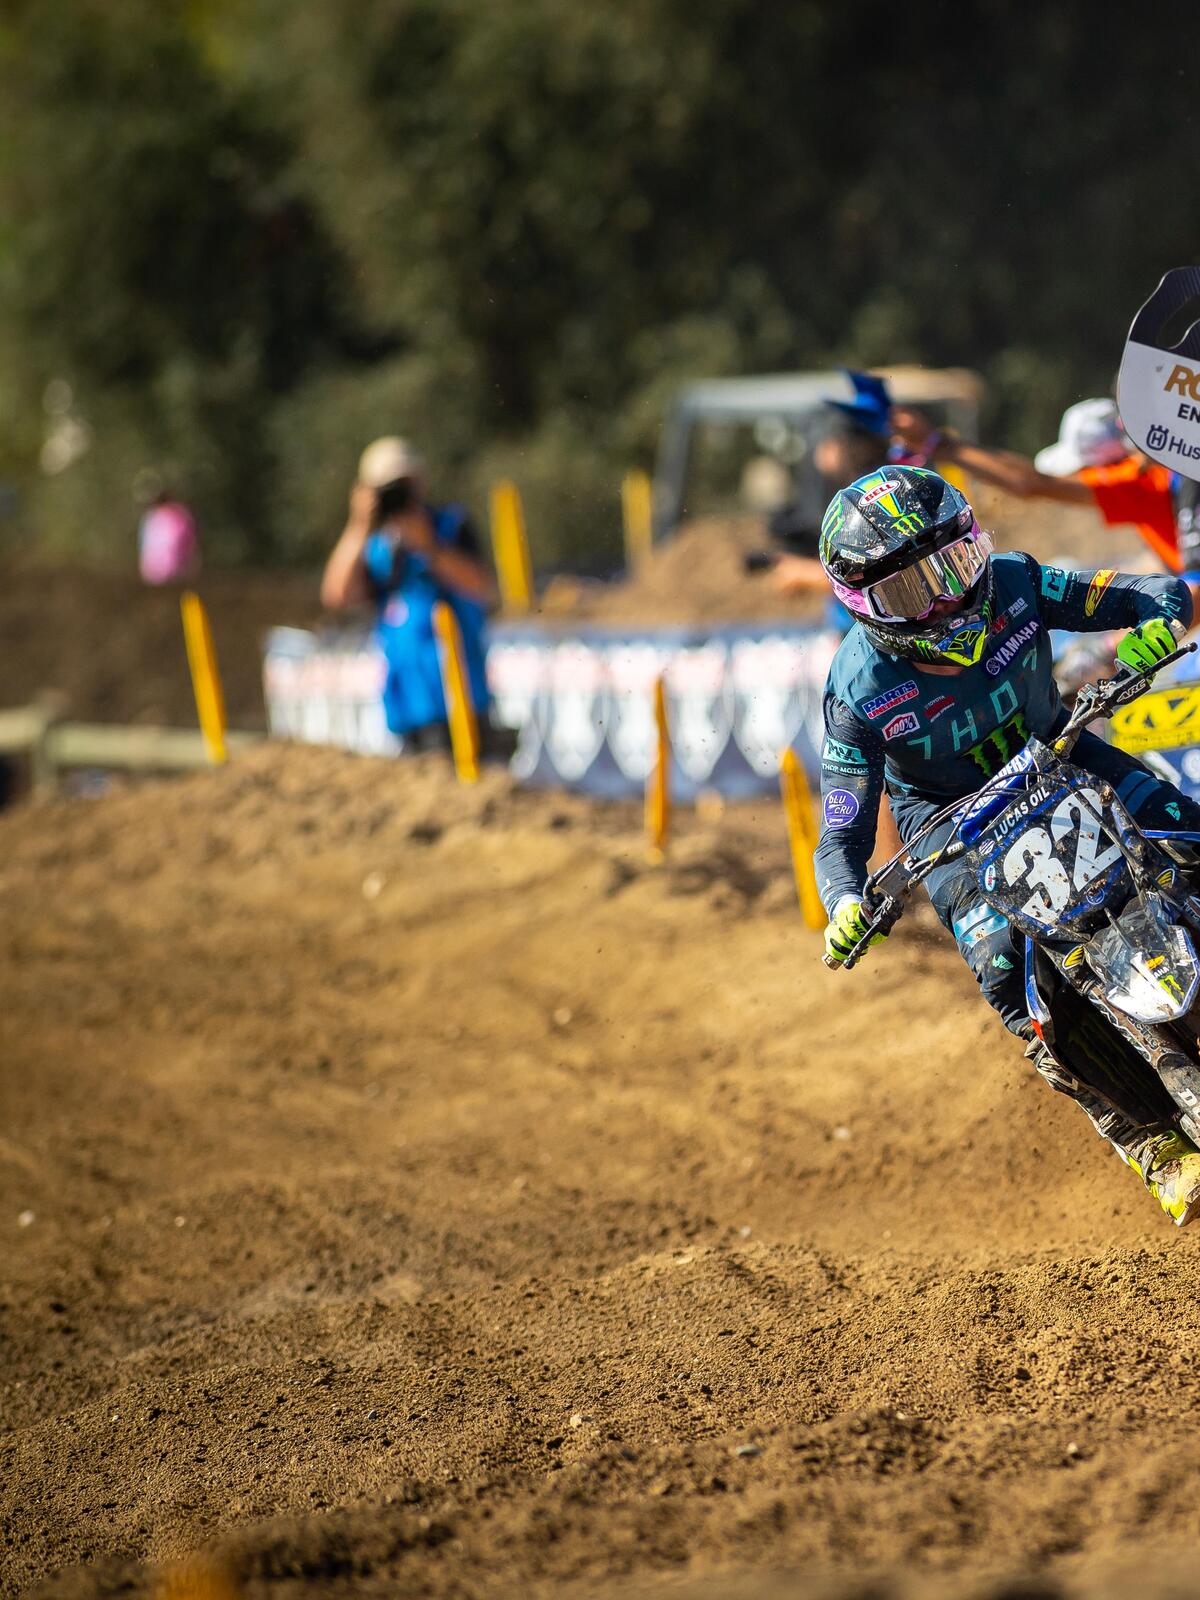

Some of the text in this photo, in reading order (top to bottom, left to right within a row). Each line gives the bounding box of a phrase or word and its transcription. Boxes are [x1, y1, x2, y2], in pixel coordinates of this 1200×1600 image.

[864, 481, 893, 502] BELL
[1007, 597, 1026, 614] PRO
[995, 621, 1040, 667] YAMAHA
[863, 681, 917, 714] PARTS
[868, 688, 919, 718] UNLIMITED
[1116, 678, 1147, 703] ARC
[888, 716, 915, 736] 100%
[993, 801, 1029, 842] LUCAS
[1029, 786, 1051, 807] OIL
[1003, 788, 1124, 925] 32
